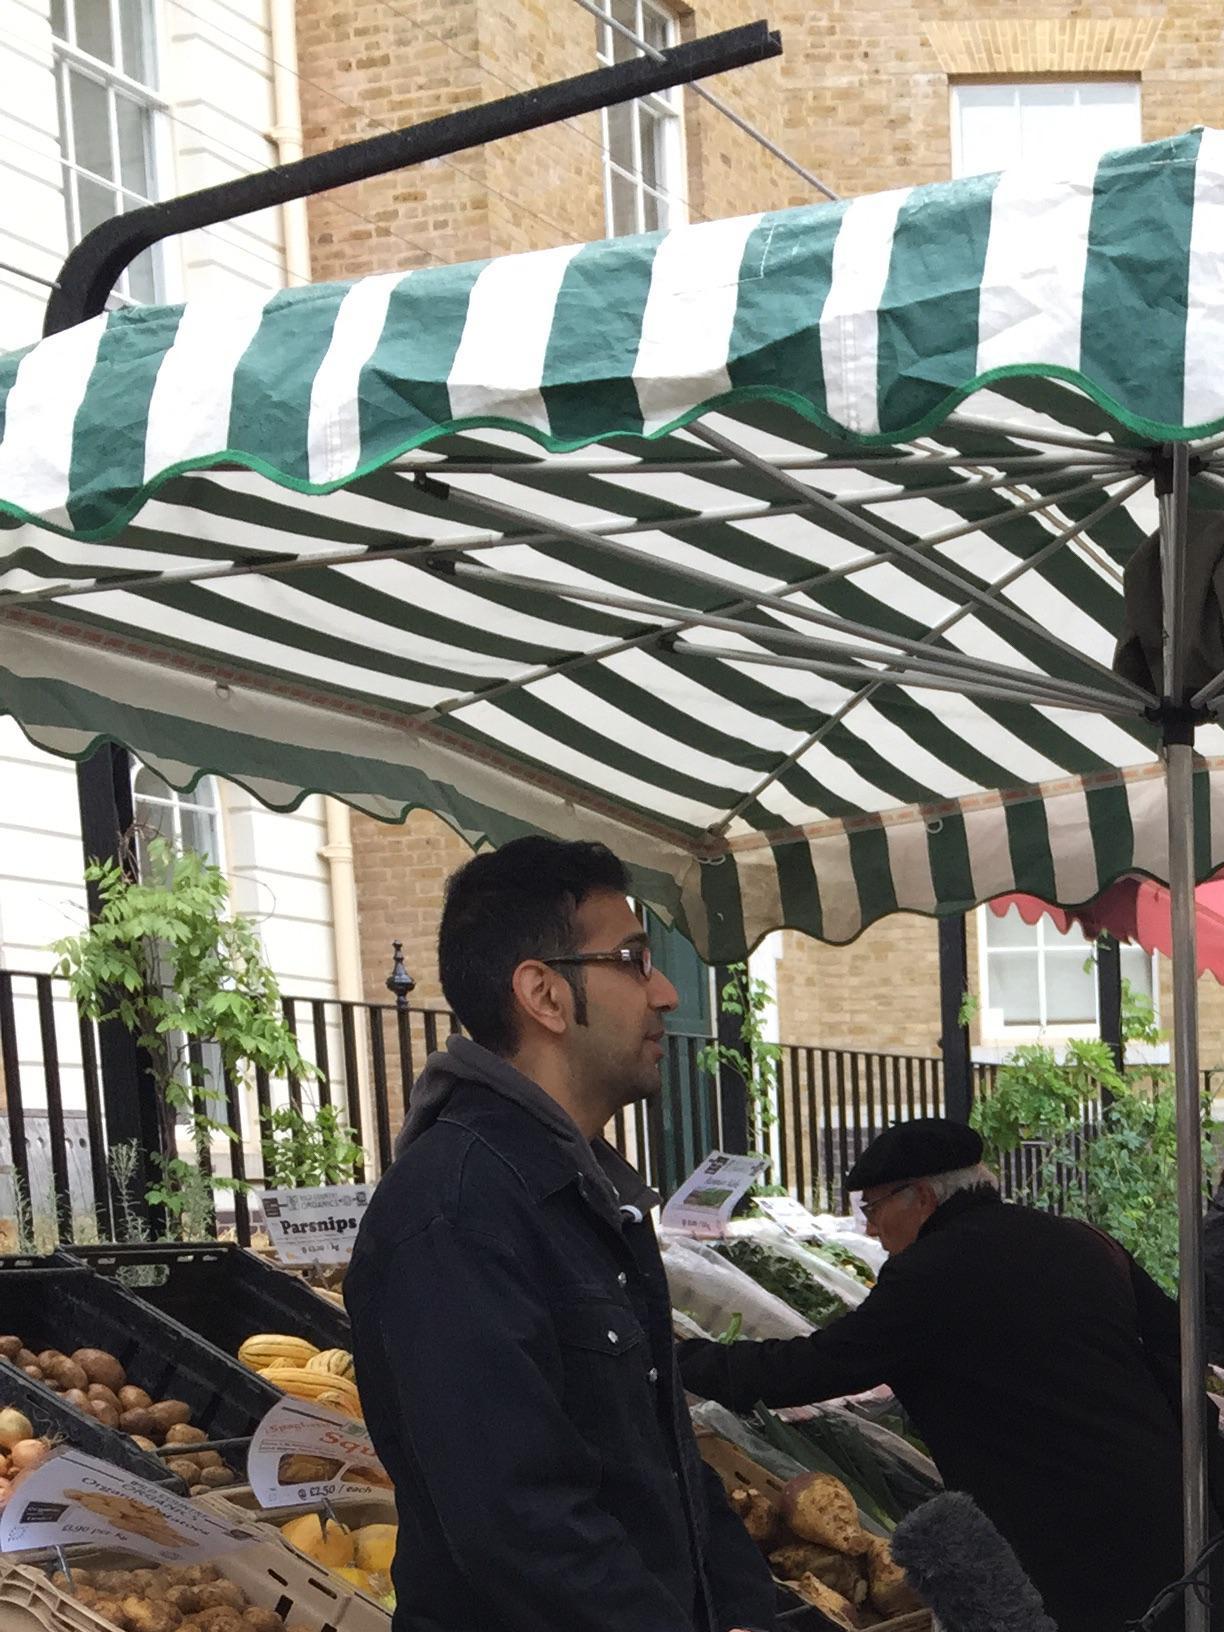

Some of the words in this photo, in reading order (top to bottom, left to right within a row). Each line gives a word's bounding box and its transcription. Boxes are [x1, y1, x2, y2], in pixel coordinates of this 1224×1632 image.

[280, 1216, 357, 1234] Parsnips
[320, 1431, 376, 1456] Squ
[346, 1486, 372, 1494] each
